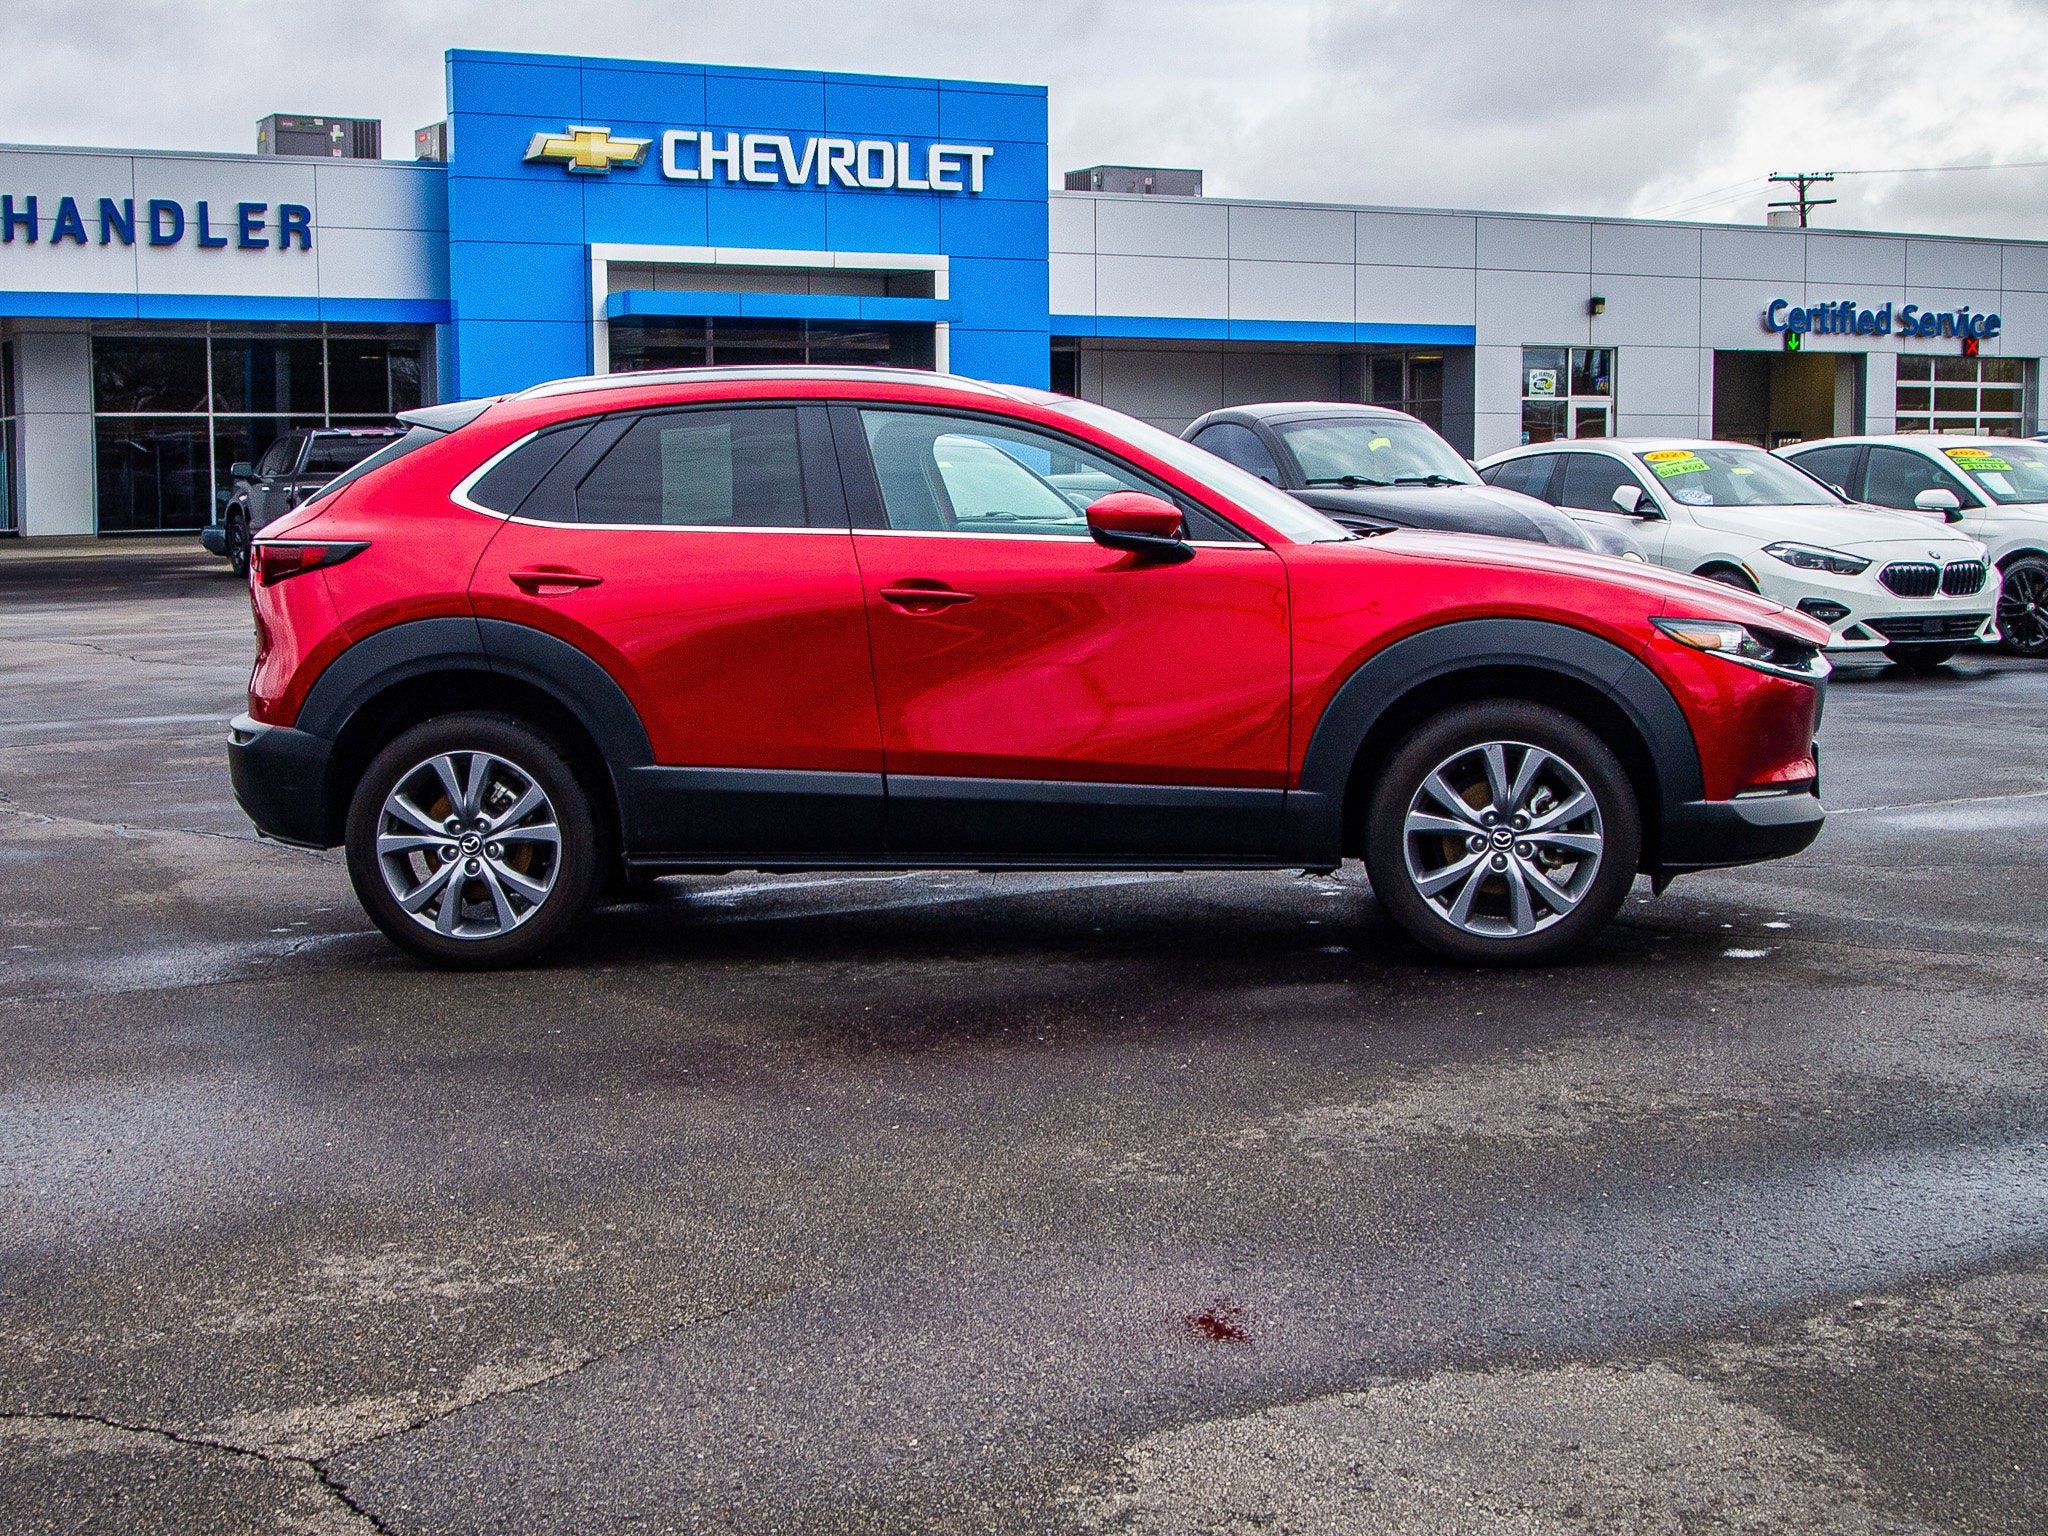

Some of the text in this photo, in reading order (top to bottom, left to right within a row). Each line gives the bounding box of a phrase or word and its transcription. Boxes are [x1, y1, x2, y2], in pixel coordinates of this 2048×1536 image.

[660, 129, 995, 194] CHEVROLET
[2, 194, 313, 250] HANDLER
[1766, 298, 2001, 339] Certified Service
[1651, 451, 1686, 460] 2021
[1660, 464, 1705, 476] SUN ROOF
